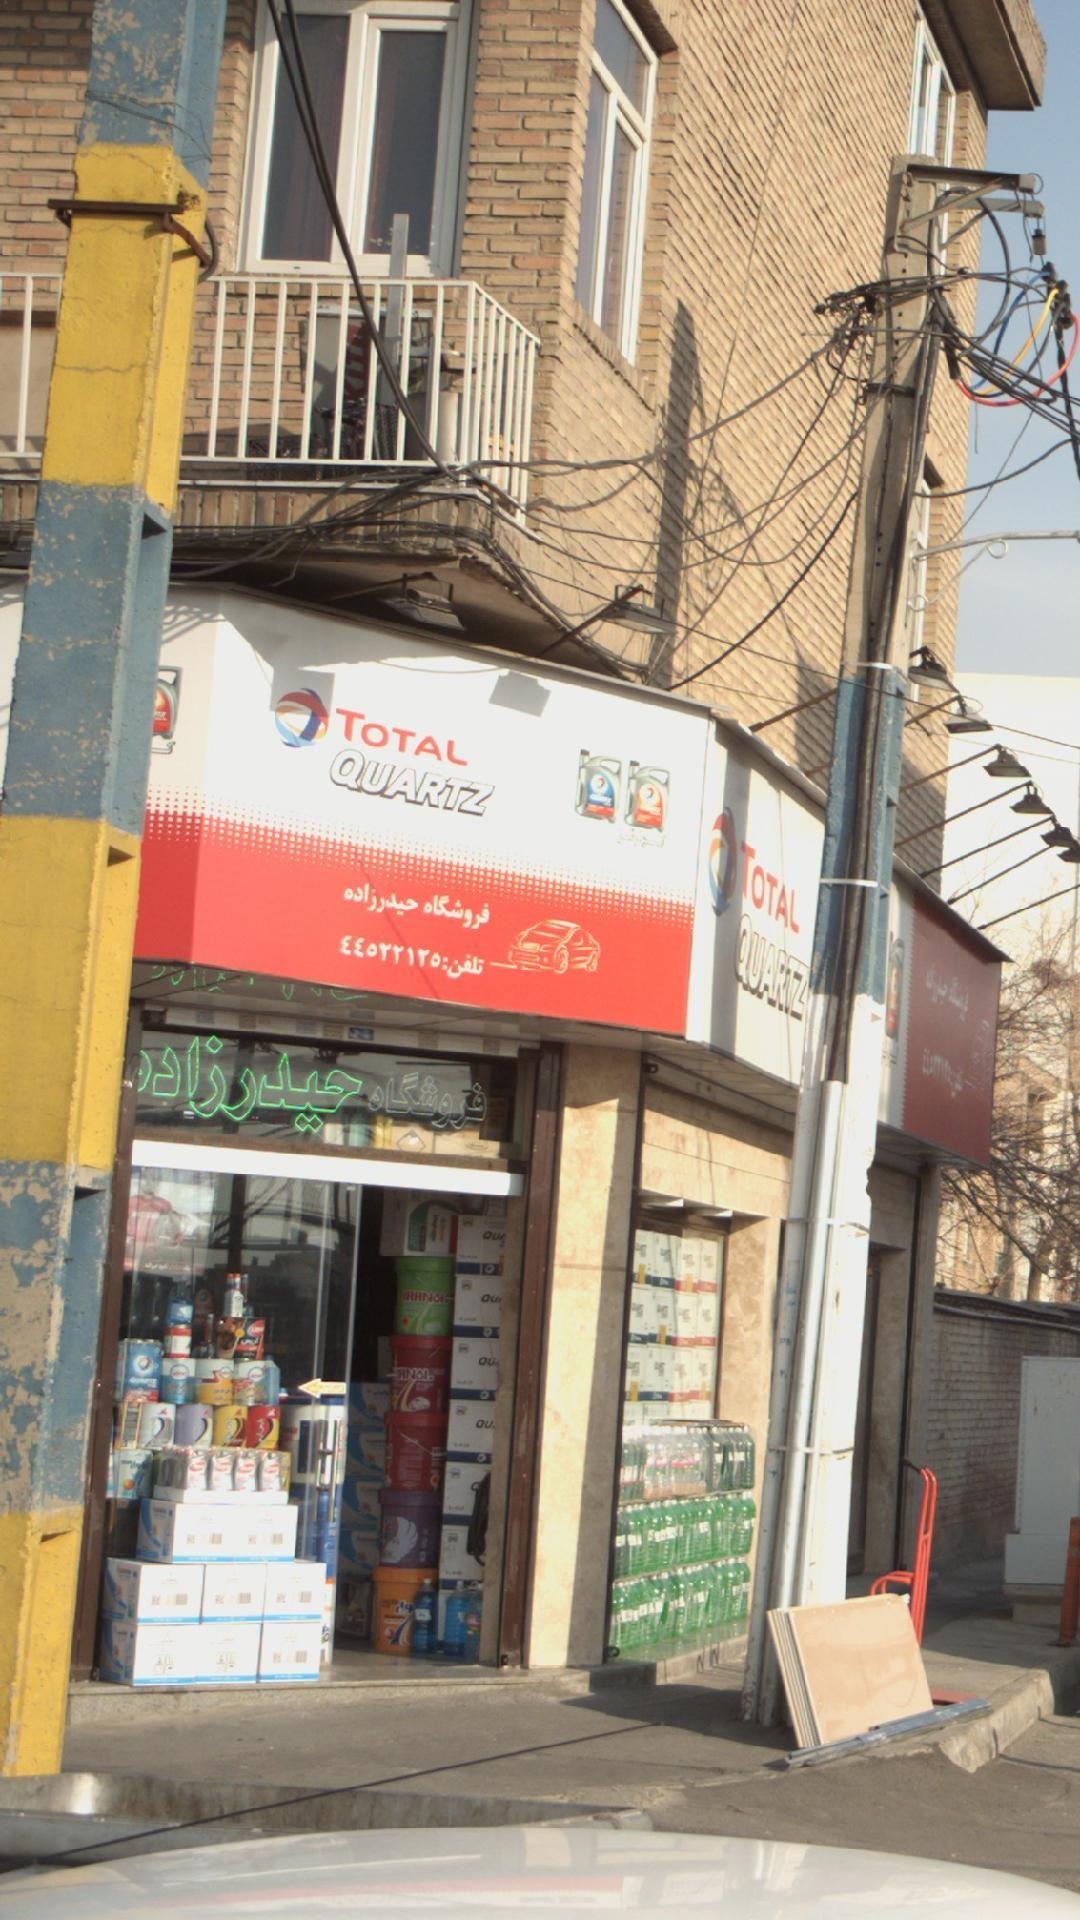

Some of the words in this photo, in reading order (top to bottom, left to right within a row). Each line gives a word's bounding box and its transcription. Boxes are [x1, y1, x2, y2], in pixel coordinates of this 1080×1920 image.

[336, 708, 467, 766] TOTAL
[330, 749, 495, 816] QUARTZ
[343, 882, 419, 916] حیدرزاده
[423, 894, 491, 930] فروشگاه
[741, 840, 800, 935] TOTAL
[736, 913, 810, 1021] QUARTZ
